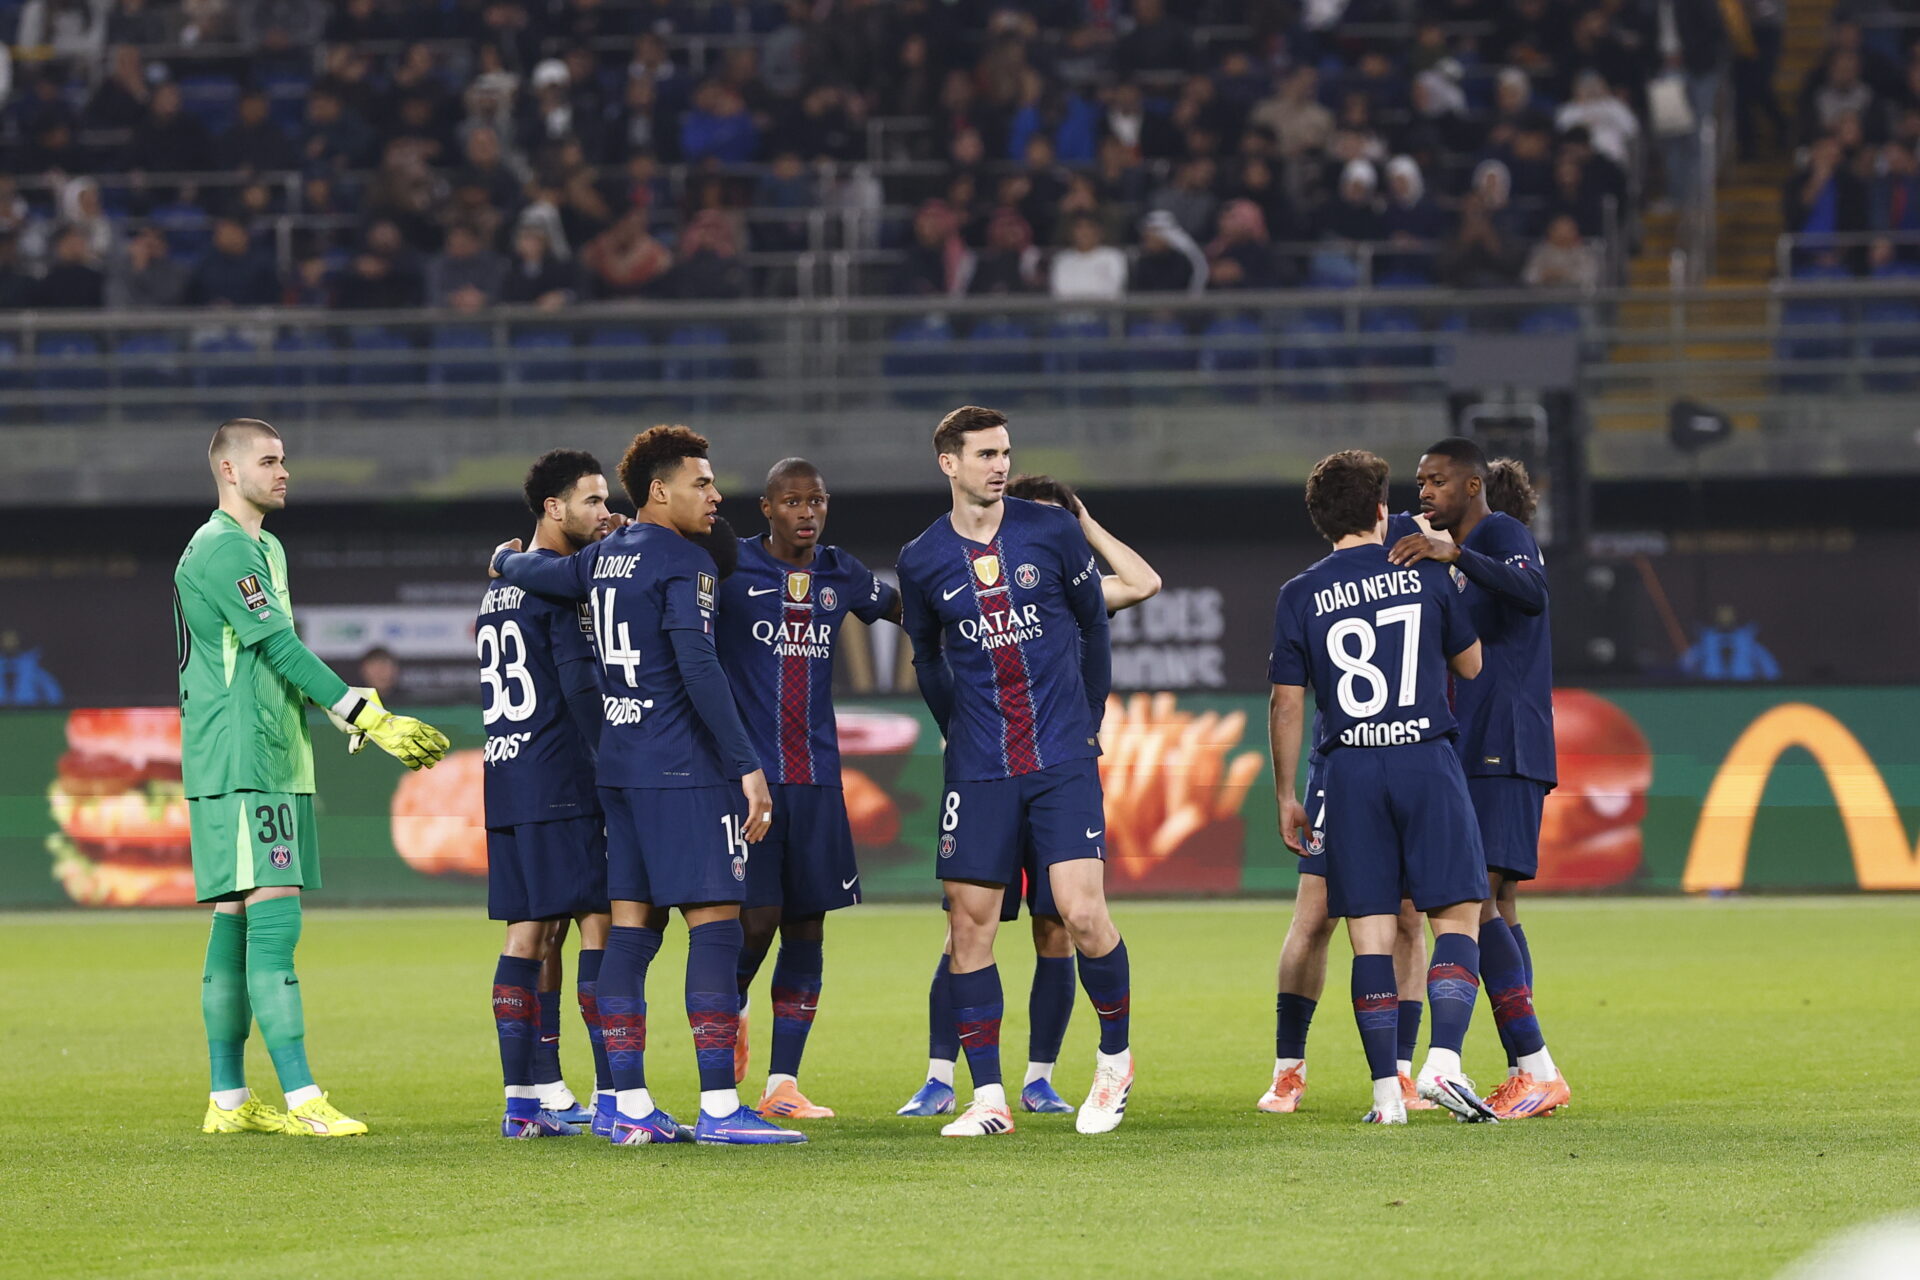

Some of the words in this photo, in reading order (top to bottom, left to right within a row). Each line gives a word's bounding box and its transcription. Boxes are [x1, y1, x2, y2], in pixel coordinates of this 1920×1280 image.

[593, 553, 641, 579] D.DOUÉ
[1314, 581, 1360, 616] JOÃO
[1361, 570, 1422, 602] NEVES
[590, 586, 641, 688] 14
[752, 620, 832, 646] QATAR
[958, 603, 1041, 643] QATAR
[981, 624, 1043, 651] AIRWAYS
[773, 643, 830, 659] AIRWAYS
[1326, 603, 1422, 719] 87
[477, 619, 537, 725] 33
[255, 803, 295, 843] 30
[942, 791, 961, 831] 8
